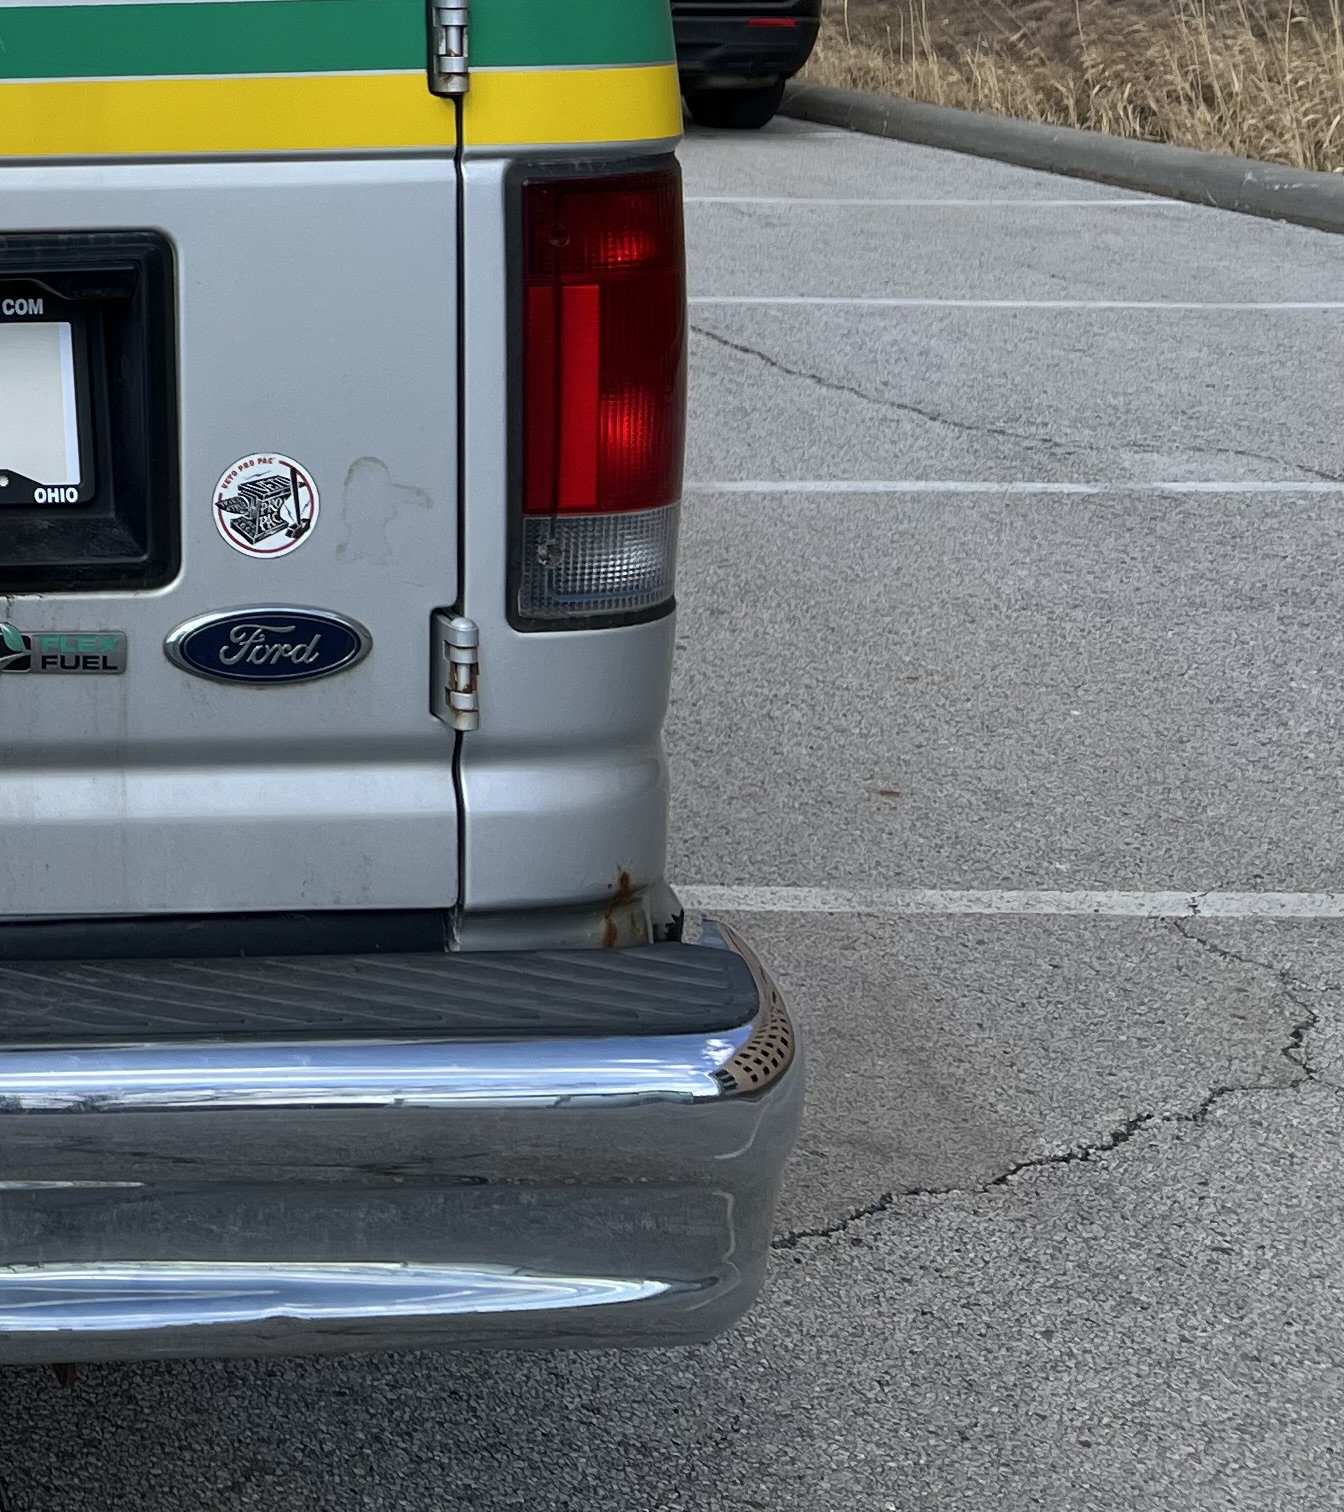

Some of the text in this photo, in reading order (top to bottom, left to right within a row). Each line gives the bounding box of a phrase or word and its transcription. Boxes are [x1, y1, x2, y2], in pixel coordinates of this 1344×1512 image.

[34, 485, 79, 504] OHIO
[40, 635, 118, 653] FLEX
[219, 624, 321, 666] Ford
[41, 655, 118, 670] FUEL
